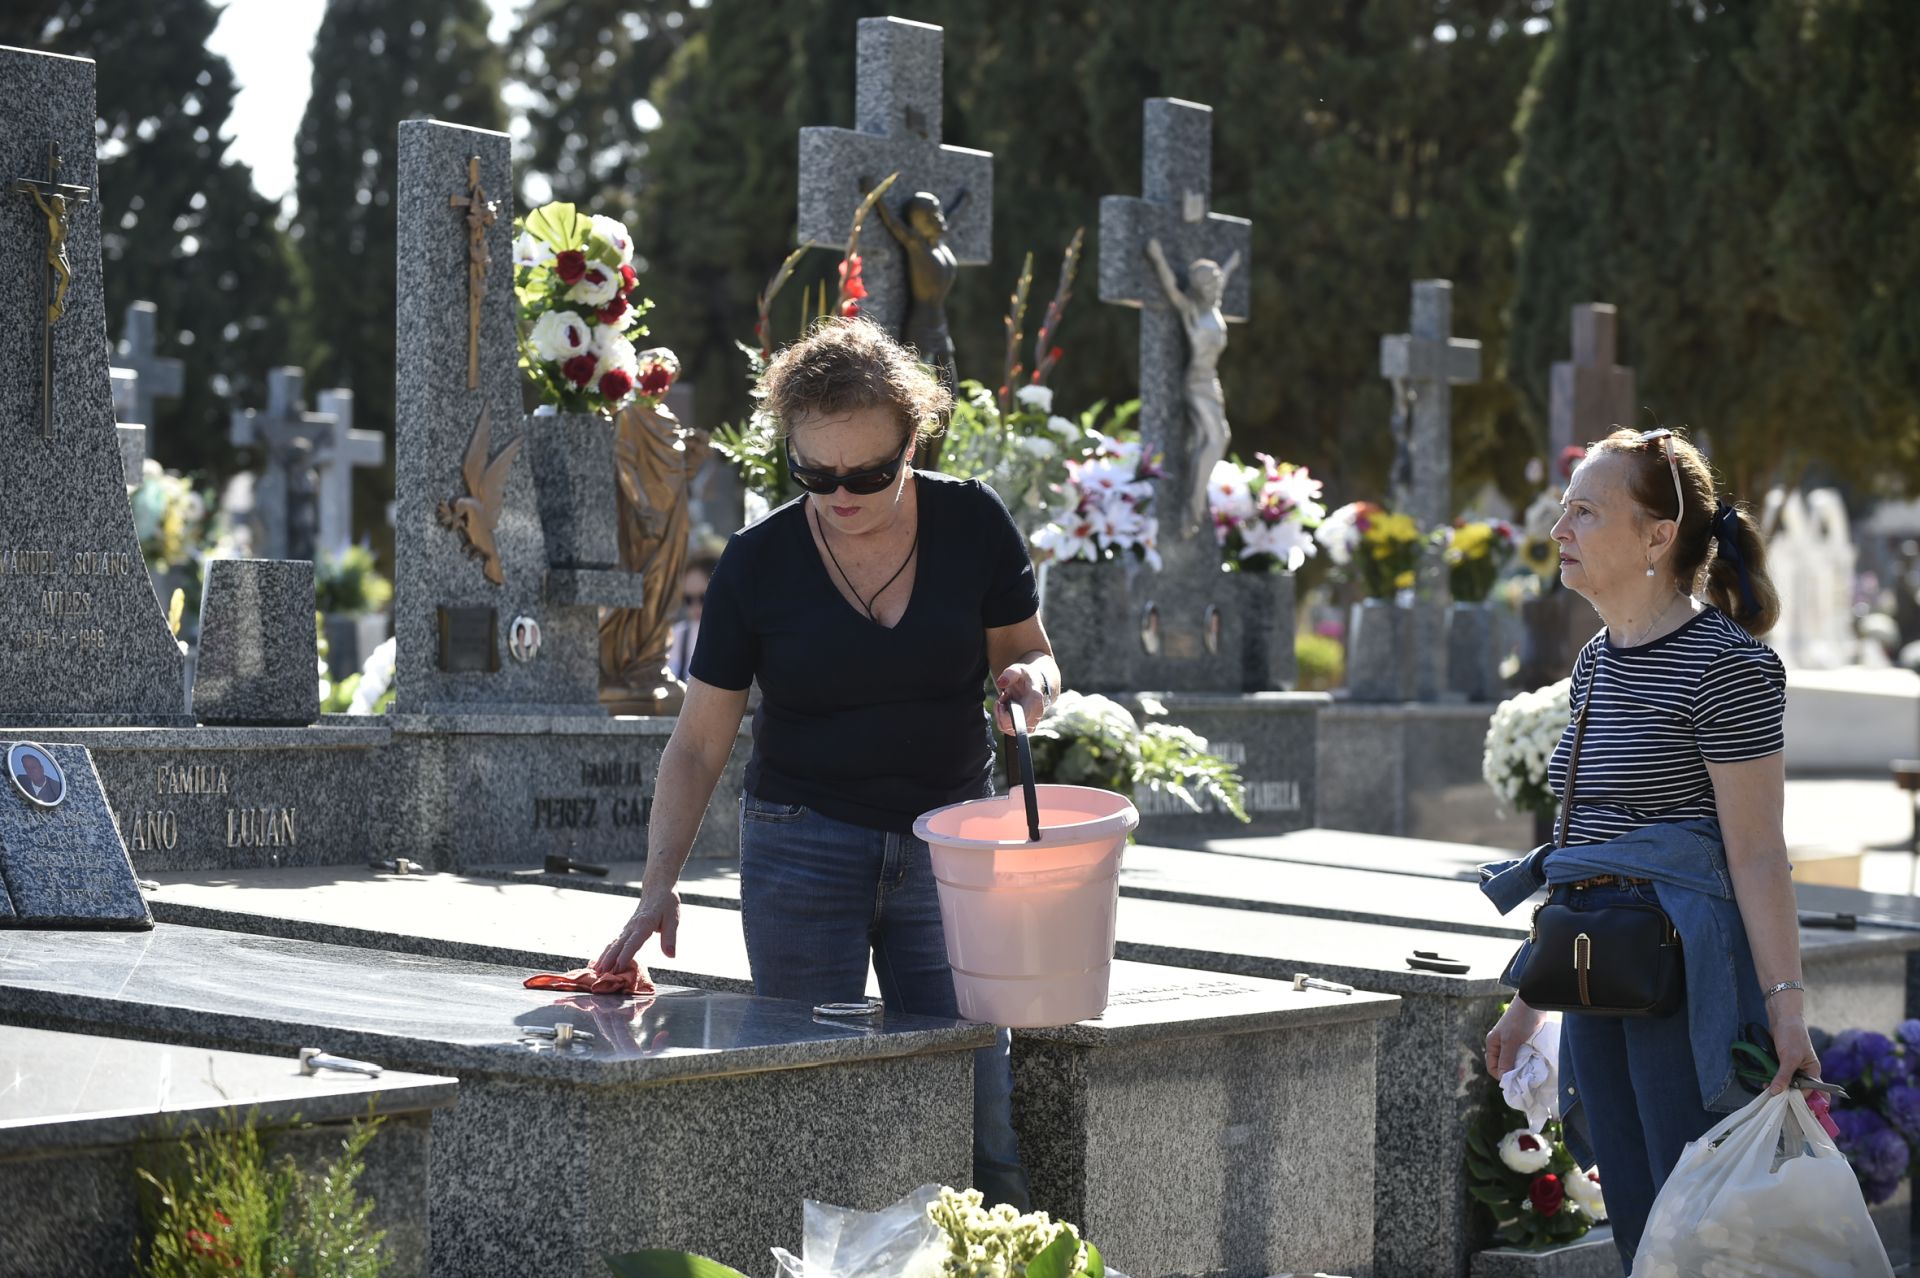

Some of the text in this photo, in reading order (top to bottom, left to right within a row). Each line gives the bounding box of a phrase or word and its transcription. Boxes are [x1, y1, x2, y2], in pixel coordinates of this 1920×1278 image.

[74, 552, 129, 576] SOLANO
[41, 591, 91, 615] AVILES
[157, 766, 227, 794] FAMILIA
[581, 760, 642, 787] FAMILIA
[227, 807, 296, 848] LUJAN
[533, 797, 597, 831] PEREZ
